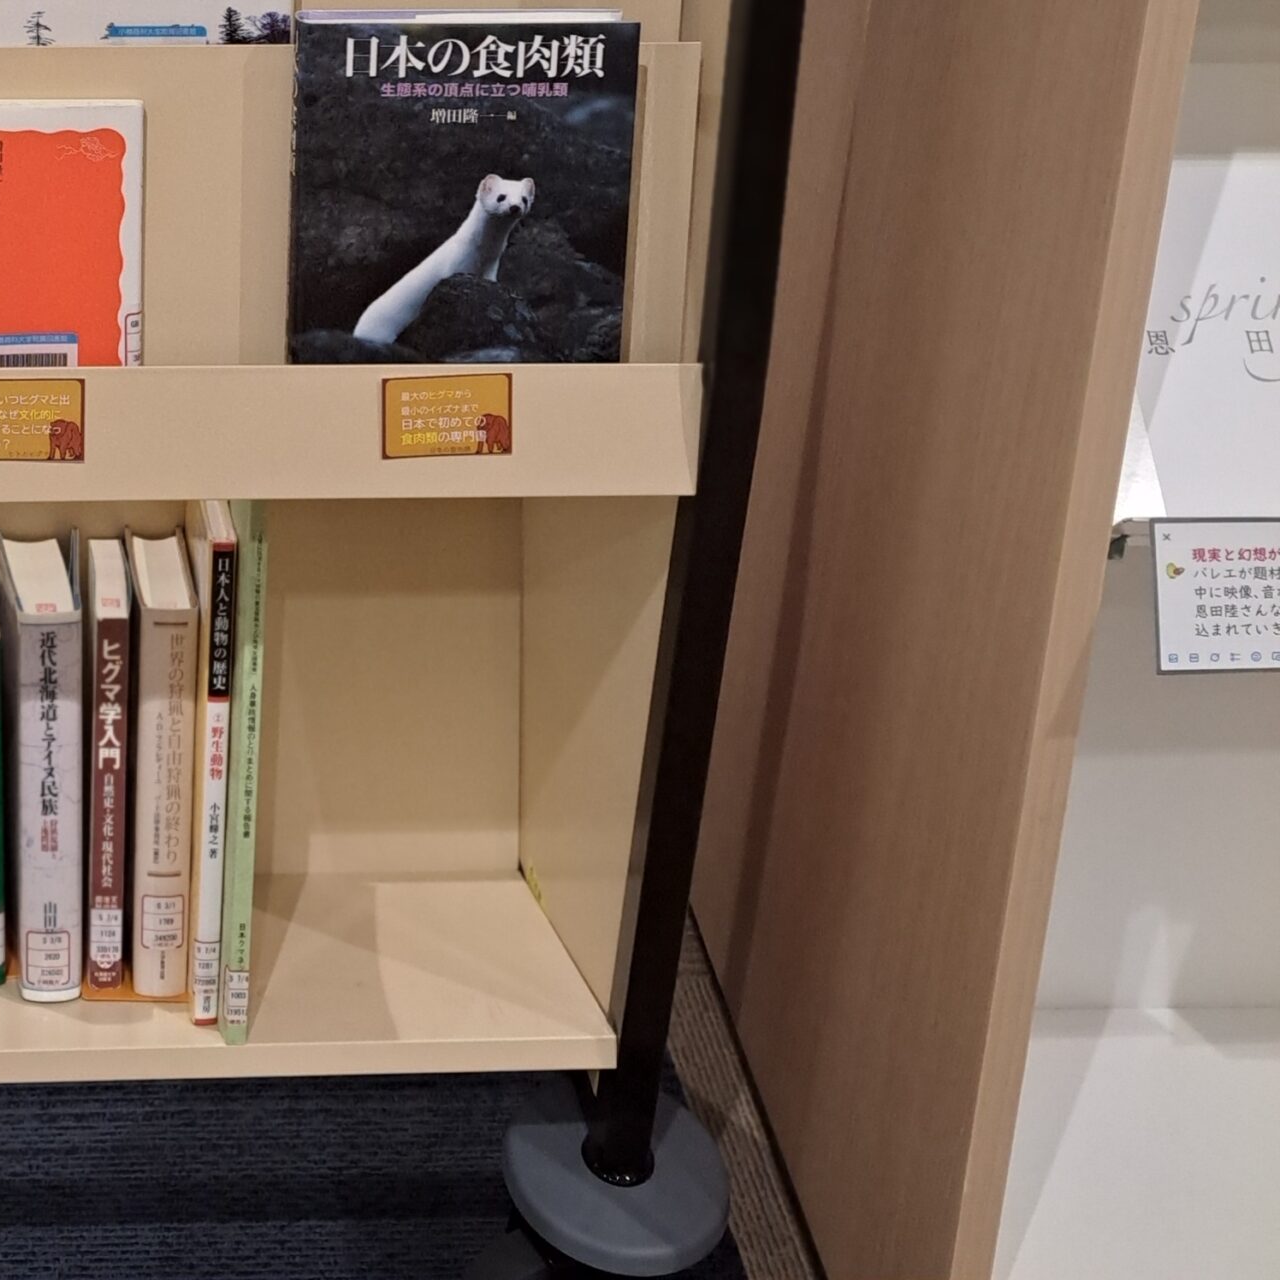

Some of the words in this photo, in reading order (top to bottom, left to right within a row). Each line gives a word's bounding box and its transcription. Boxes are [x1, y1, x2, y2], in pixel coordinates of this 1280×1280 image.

[345, 33, 607, 79] 日本の食肉類
[380, 82, 569, 98] 生態系の頂点に立つ哺乳類
[1170, 276, 1280, 347] spri
[1244, 329, 1275, 355] 田
[402, 416, 487, 431] 日本で初めての
[1194, 585, 1280, 600] 中に映像、音
[212, 557, 231, 691] 日本人と動物の歴史
[39, 631, 60, 817] 近代北海道とアイヌ民族
[98, 638, 123, 770] ヒグマ学入門
[209, 726, 224, 781] 野生動物
[101, 772, 116, 889] 自然史・文化・現代社会
[44, 901, 58, 933] 山田
